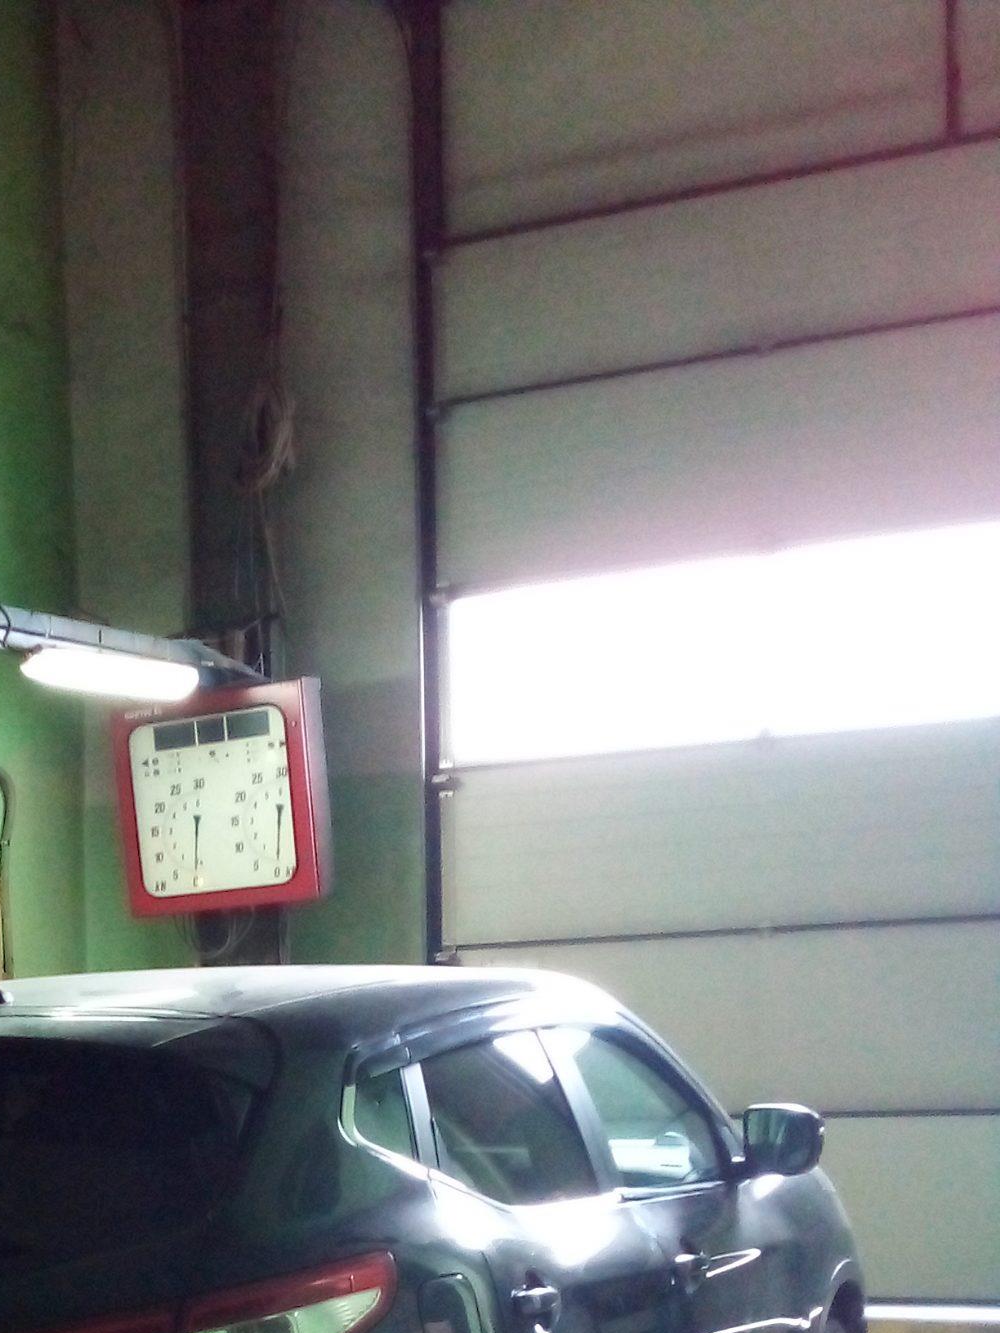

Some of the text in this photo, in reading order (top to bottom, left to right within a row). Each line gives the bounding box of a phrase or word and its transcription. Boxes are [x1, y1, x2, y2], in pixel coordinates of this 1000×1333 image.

[194, 778, 204, 790] 30
[252, 773, 262, 785] 25
[170, 783, 181, 796] 25
[235, 791, 246, 803] 20
[155, 802, 165, 814] 20
[231, 816, 239, 827] 15
[151, 826, 159, 838] 15
[235, 842, 243, 853] 10
[155, 852, 163, 862] 10
[173, 869, 178, 880] 5
